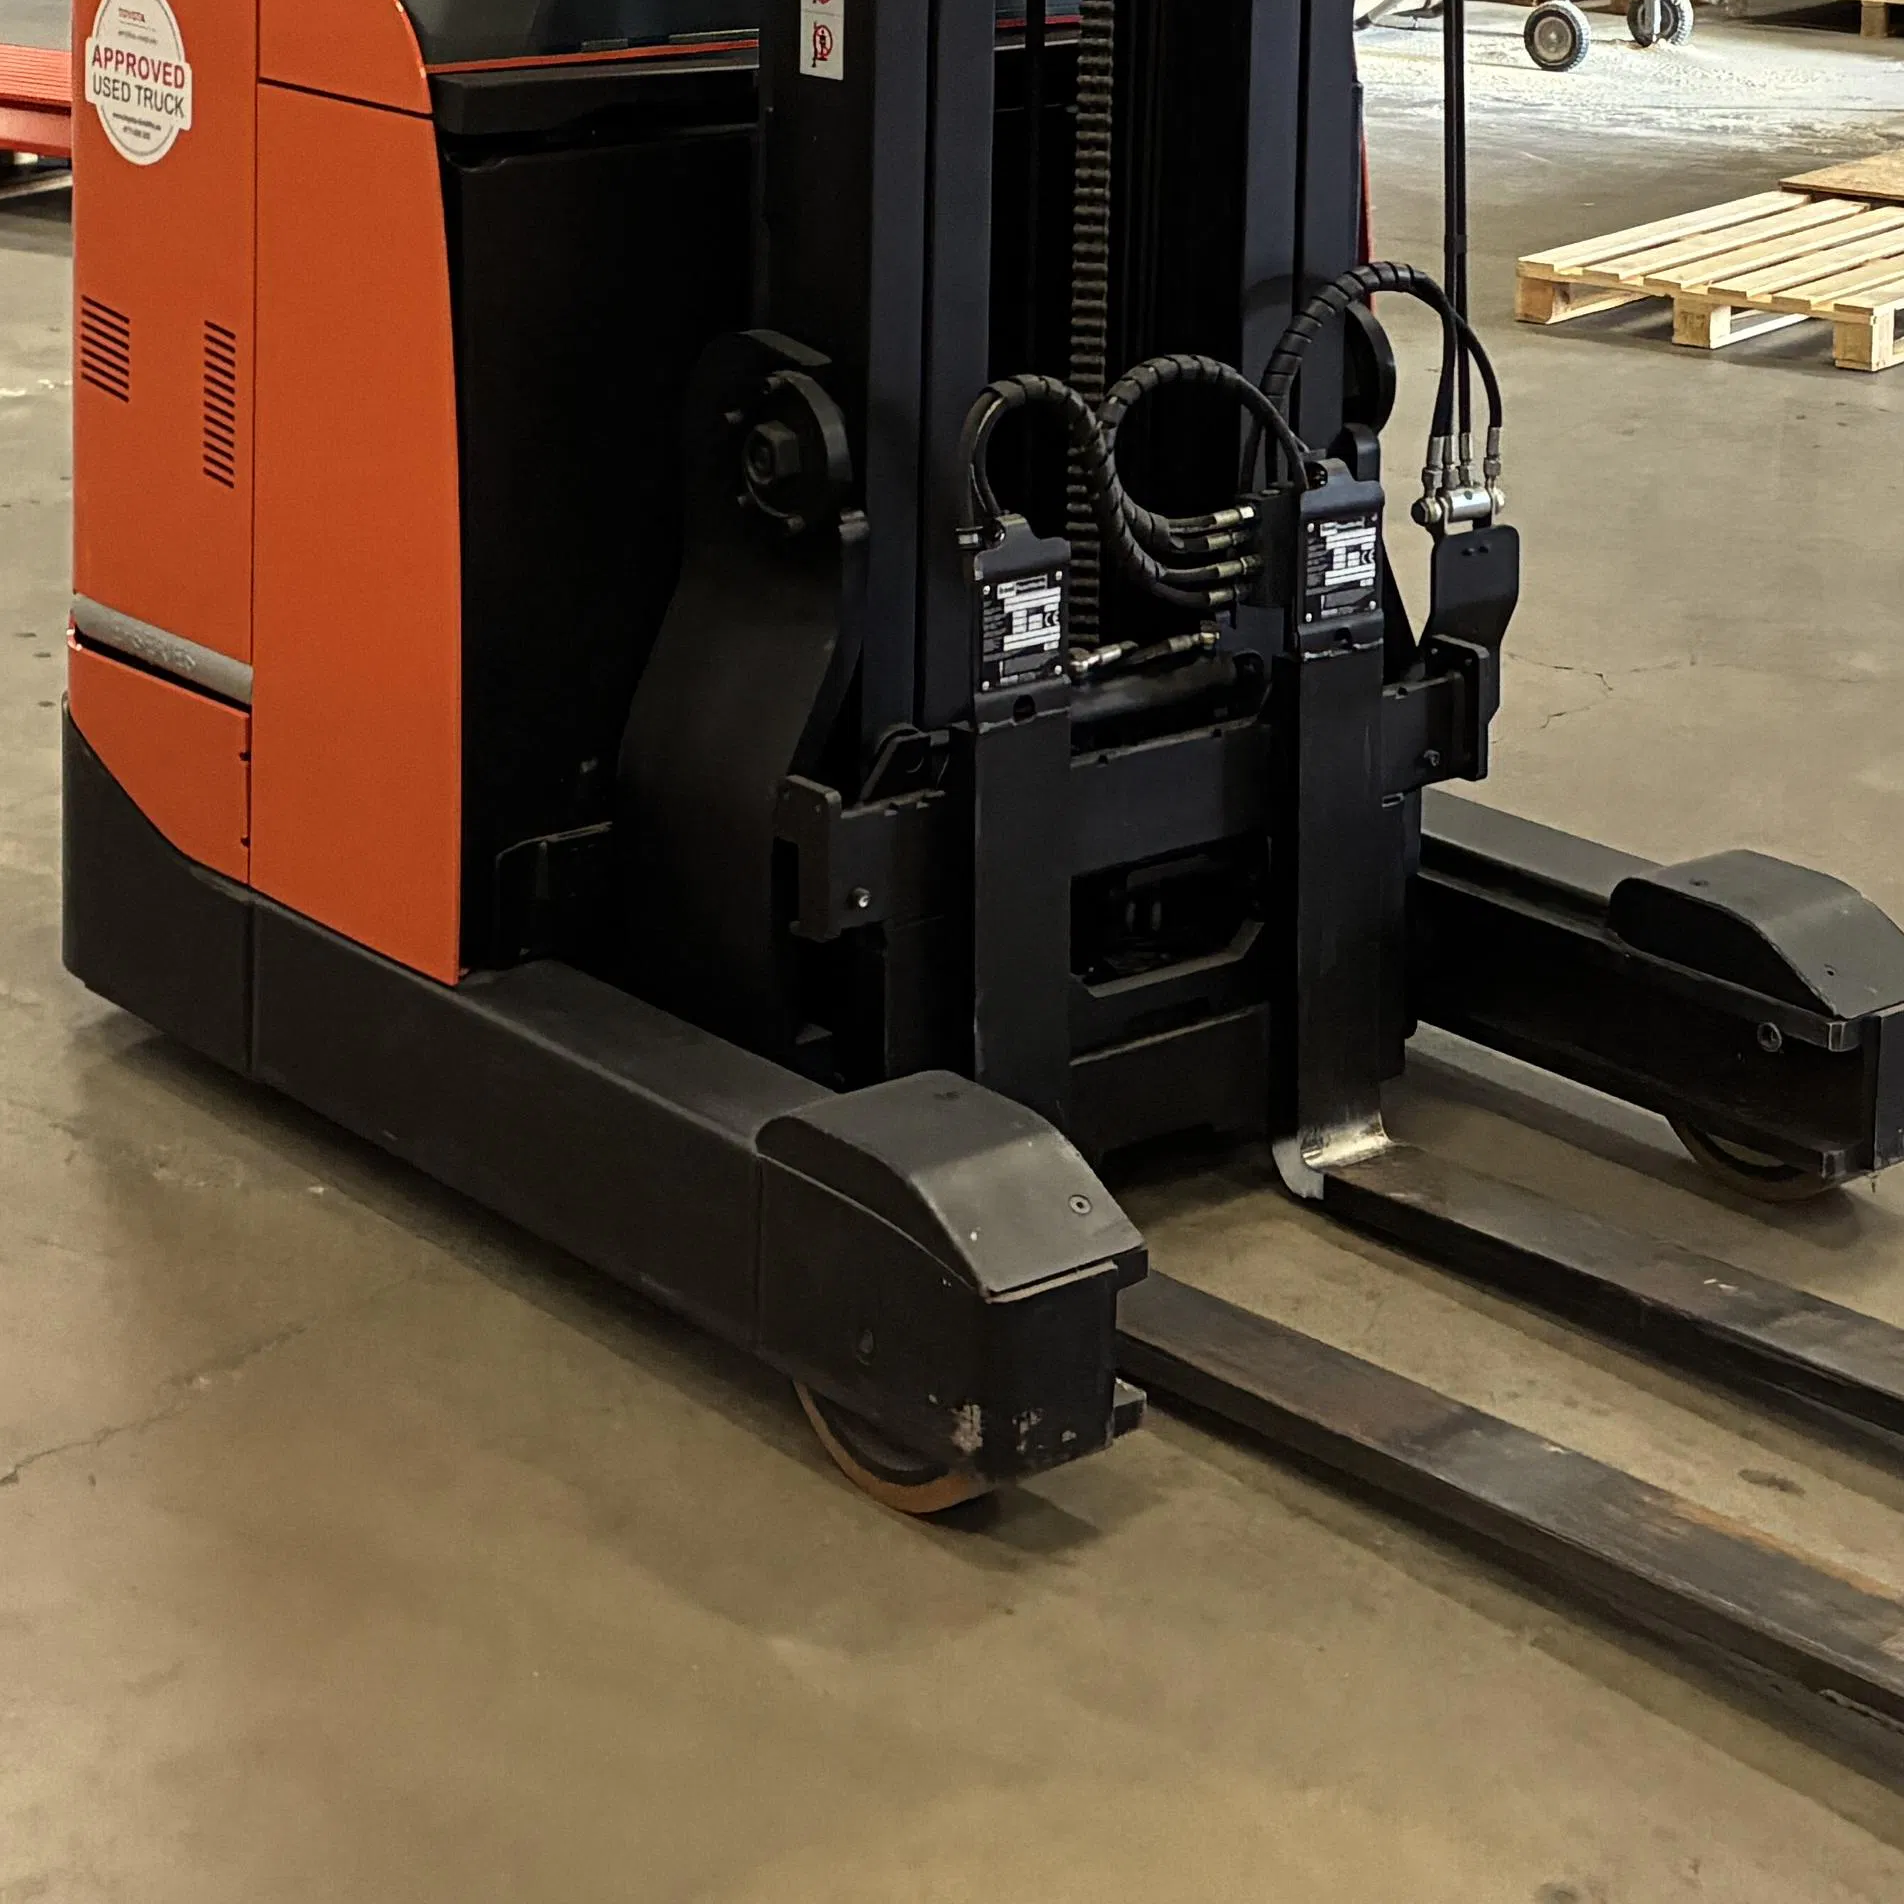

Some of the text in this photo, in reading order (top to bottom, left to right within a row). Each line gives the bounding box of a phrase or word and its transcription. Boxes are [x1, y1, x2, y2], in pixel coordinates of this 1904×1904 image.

[92, 45, 185, 90] APPROVED
[93, 74, 185, 118] USED TRUCK
